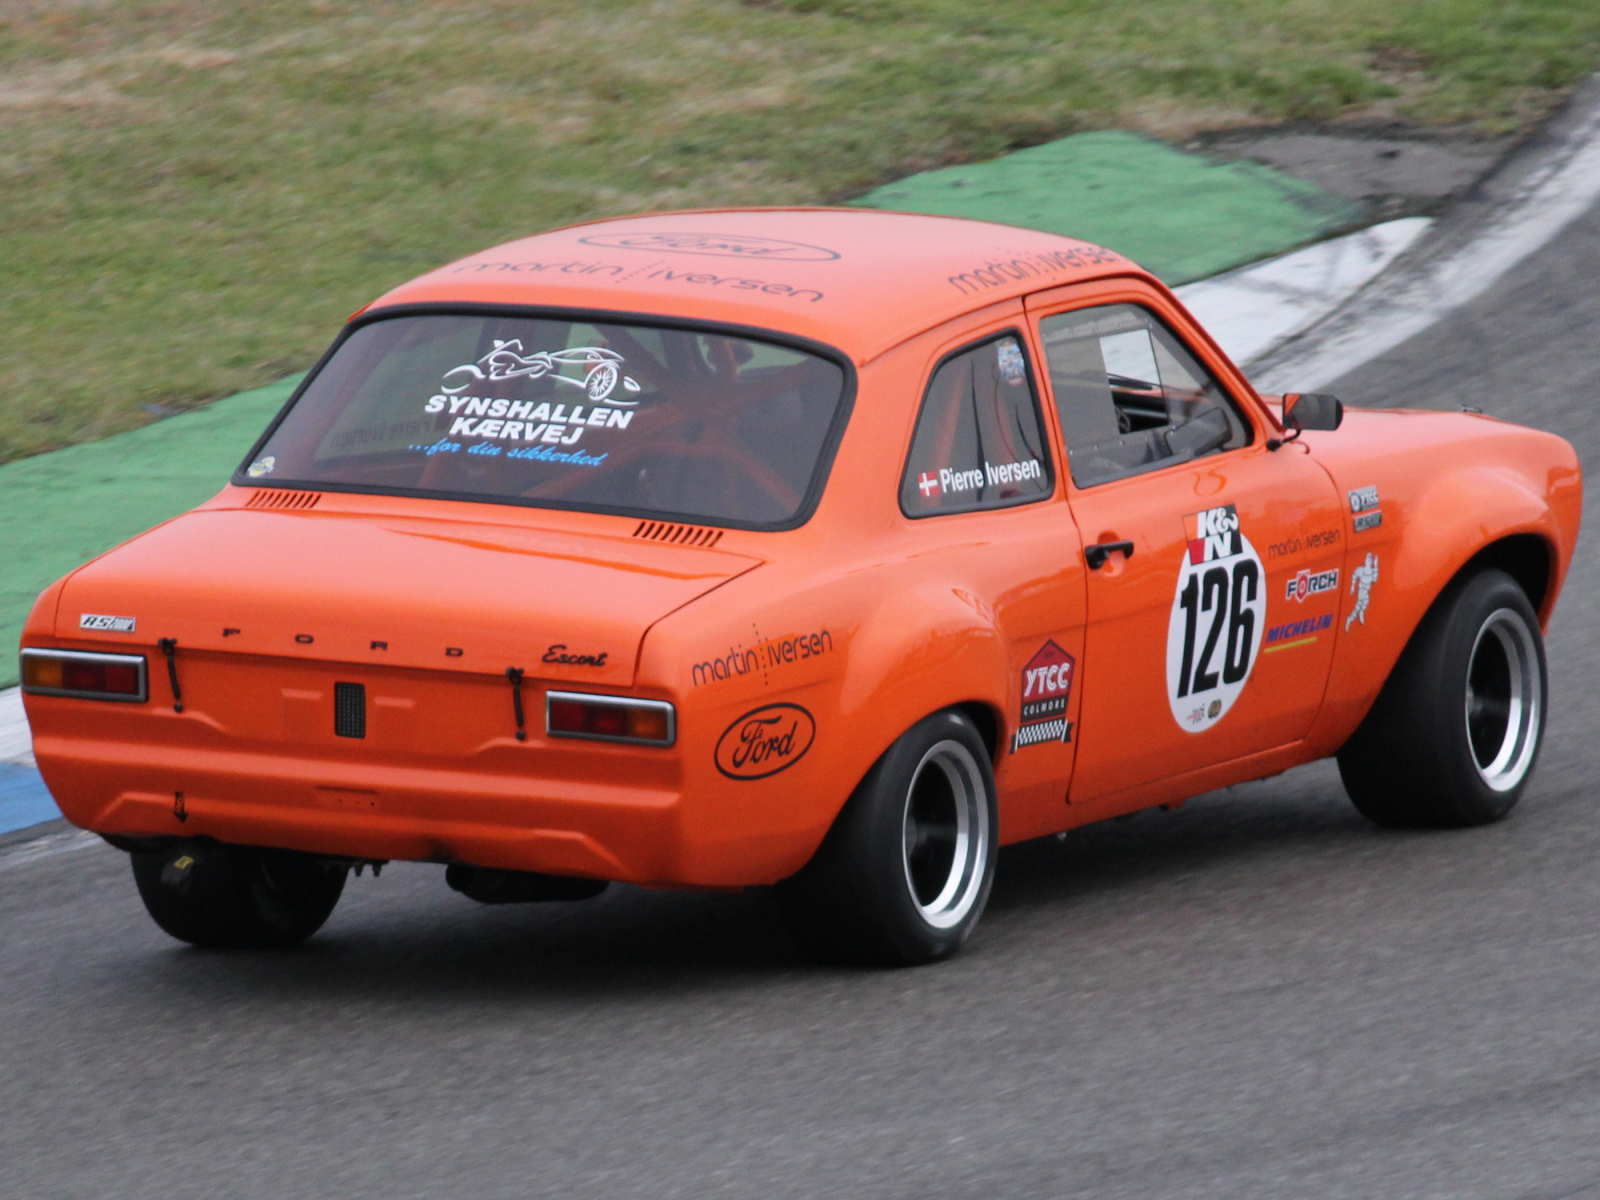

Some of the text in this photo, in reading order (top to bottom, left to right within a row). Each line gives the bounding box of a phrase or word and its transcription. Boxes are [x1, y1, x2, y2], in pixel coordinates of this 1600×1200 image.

[453, 259, 824, 302] martin iversen
[948, 258, 1041, 295] martin
[424, 394, 635, 429] SYNSHALLEN
[449, 416, 585, 446] KÆRVEJ
[467, 440, 502, 456] din
[506, 444, 609, 467] sikkerhed
[940, 459, 1041, 493] Pierre Iversen
[1268, 529, 1341, 559] martin iversen
[222, 627, 464, 658] FORD
[1177, 558, 1259, 699] 126
[1265, 613, 1333, 643] MICHELIN
[541, 644, 608, 667] Escort
[692, 630, 833, 687] martin iversen
[1023, 662, 1071, 697] YTCC
[1023, 698, 1066, 717] COLMORE
[732, 715, 799, 769] Ford
